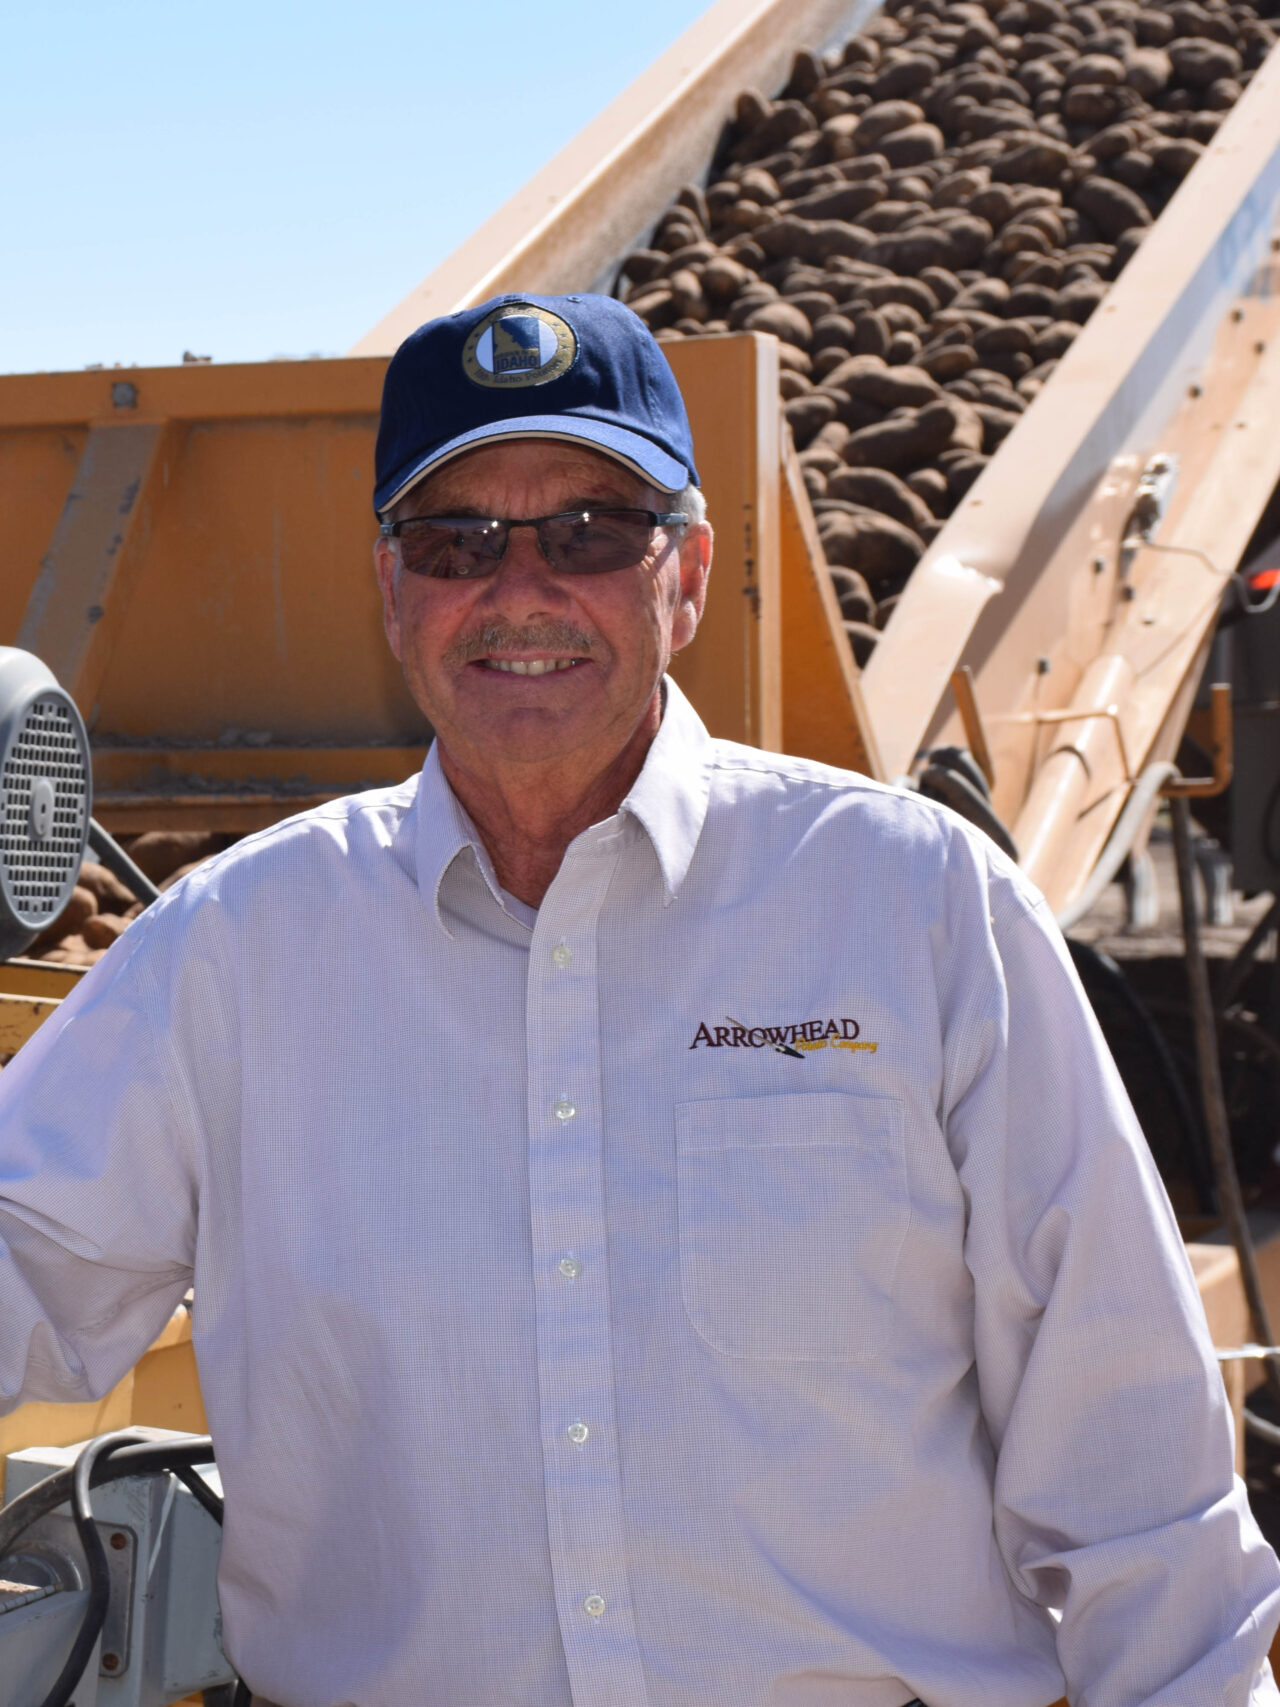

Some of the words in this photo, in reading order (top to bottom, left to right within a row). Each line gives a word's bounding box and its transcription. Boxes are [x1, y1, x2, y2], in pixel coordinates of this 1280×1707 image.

[496, 355, 538, 370] IDAHO
[688, 1018, 860, 1050] ARROWHEAD
[830, 1033, 879, 1053] Company
